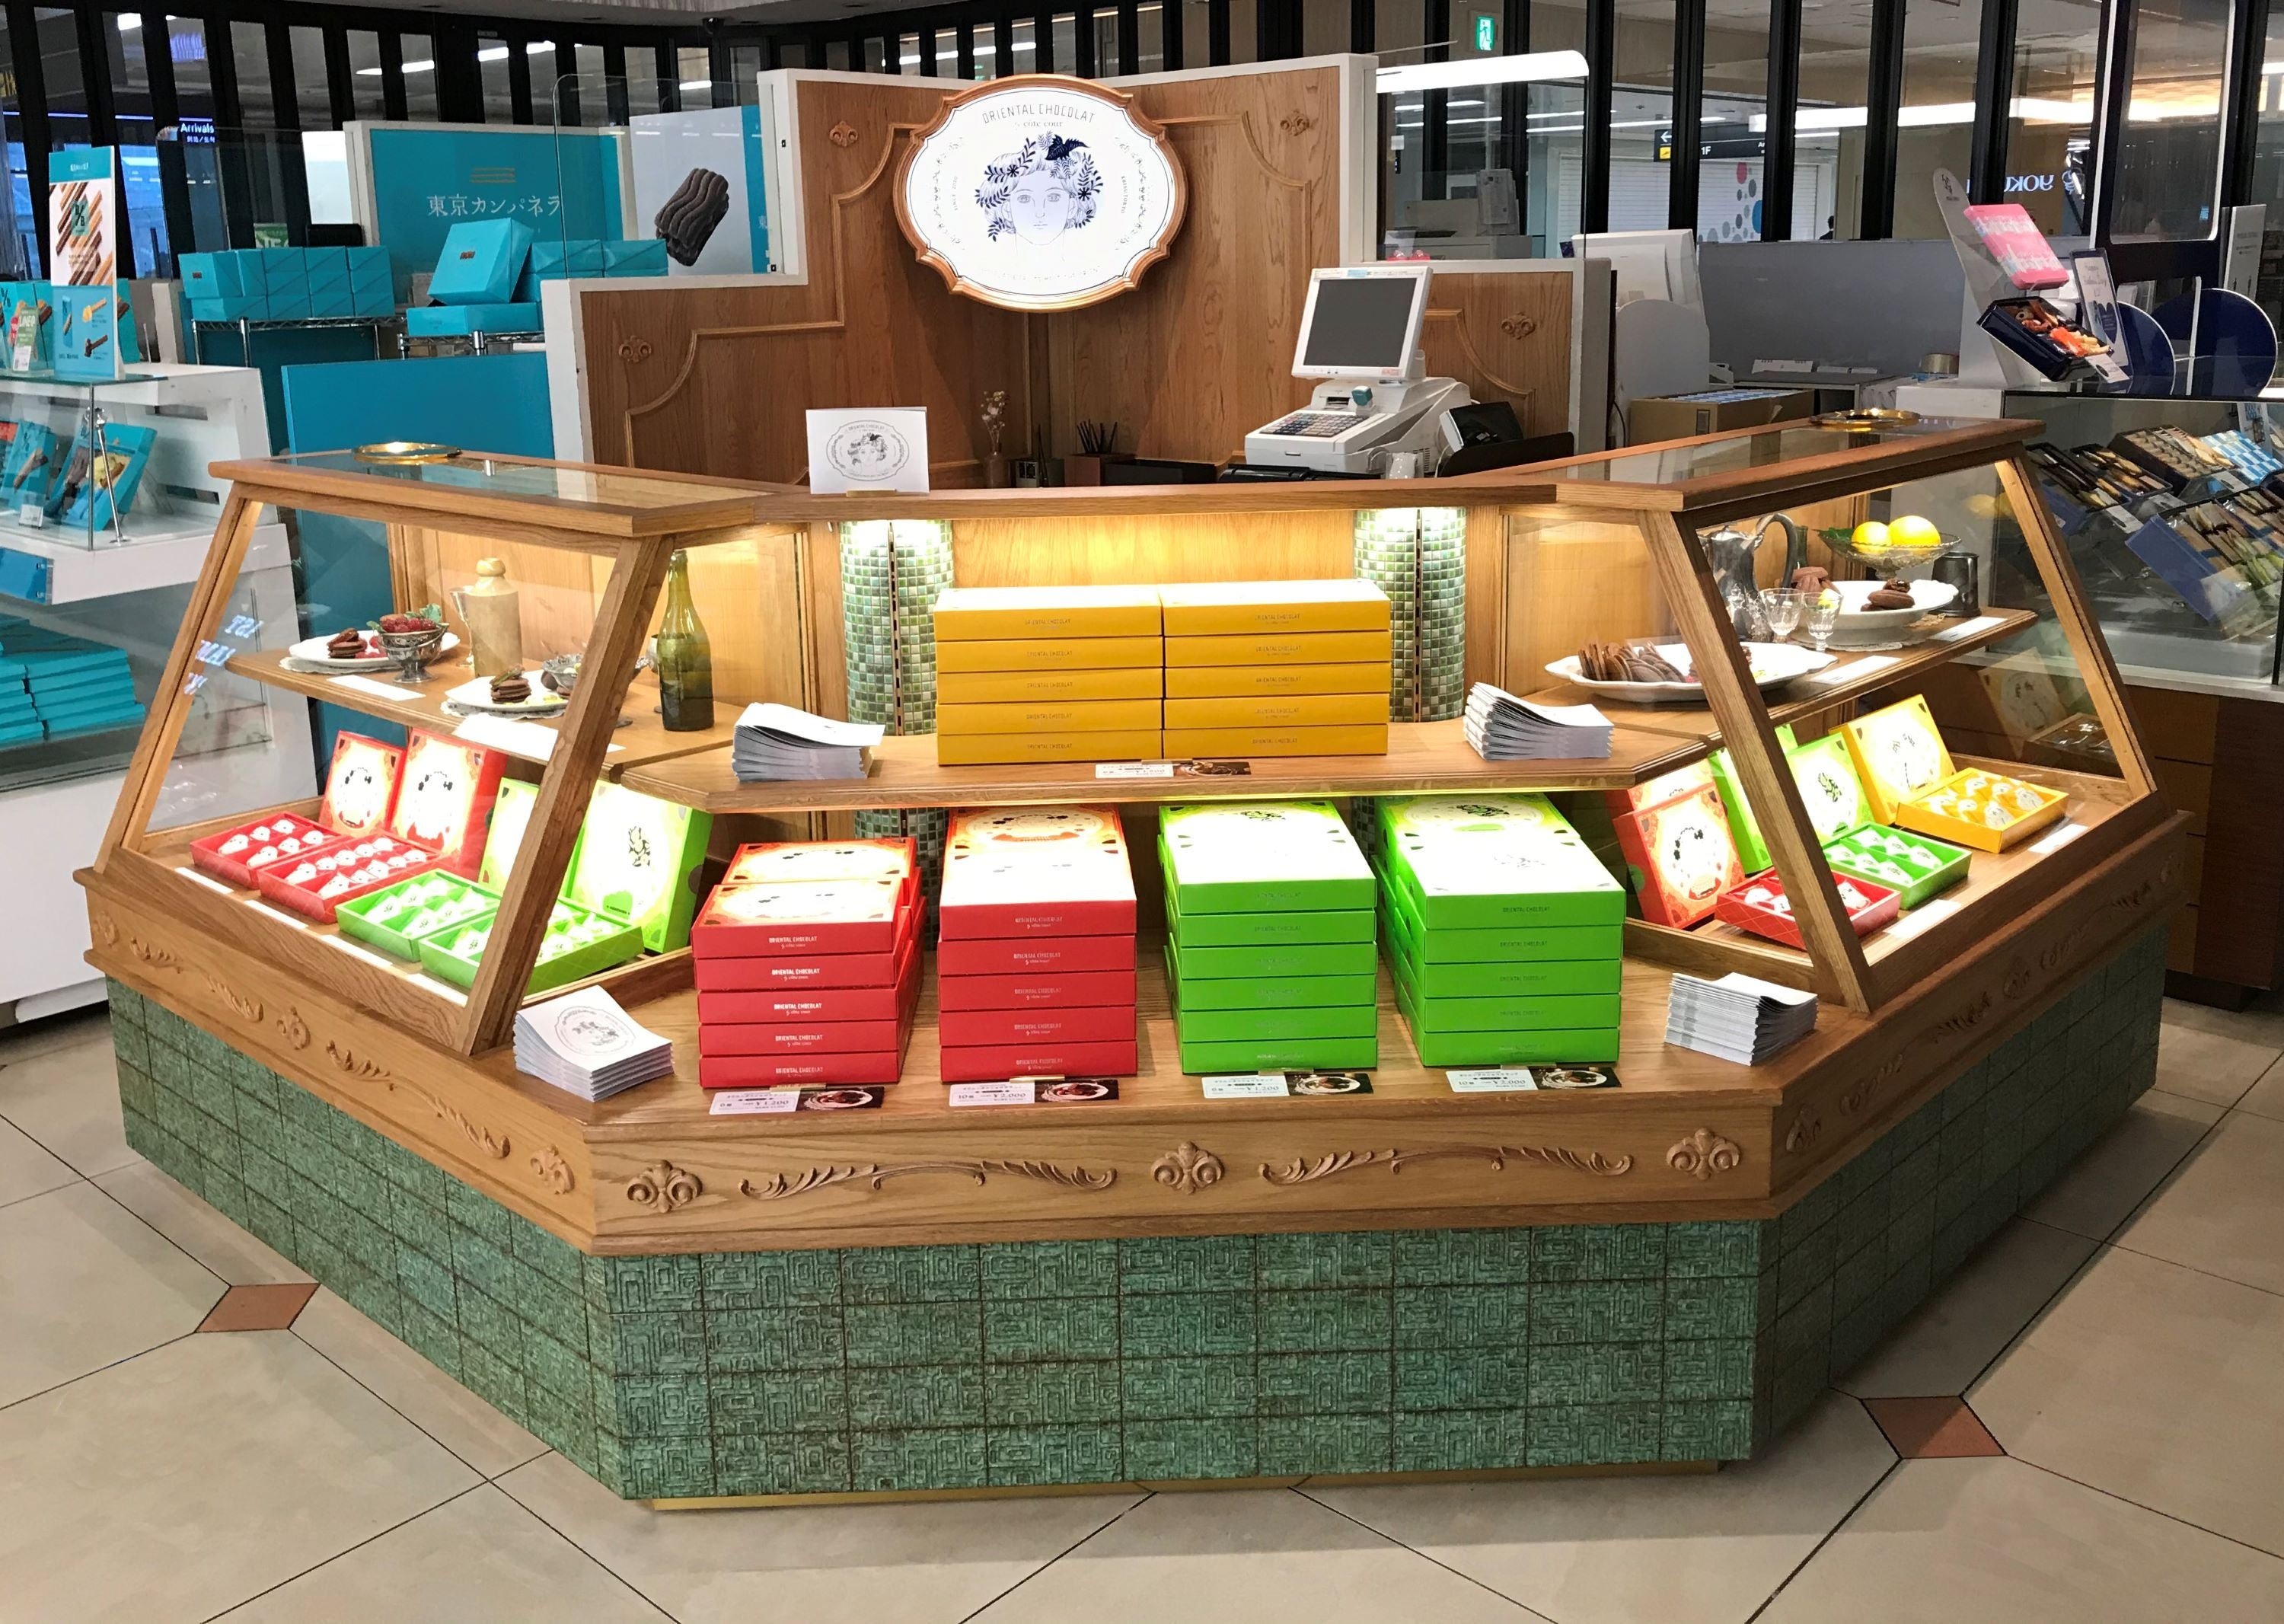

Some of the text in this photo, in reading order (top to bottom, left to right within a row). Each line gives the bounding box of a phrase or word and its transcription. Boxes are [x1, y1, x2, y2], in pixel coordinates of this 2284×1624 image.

[982, 104, 1096, 124] ORIENTAL CHOCOLAT
[180, 123, 215, 134] Arrivals
[1701, 146, 1711, 155] 1F
[427, 194, 561, 217] 東京カンパネラ
